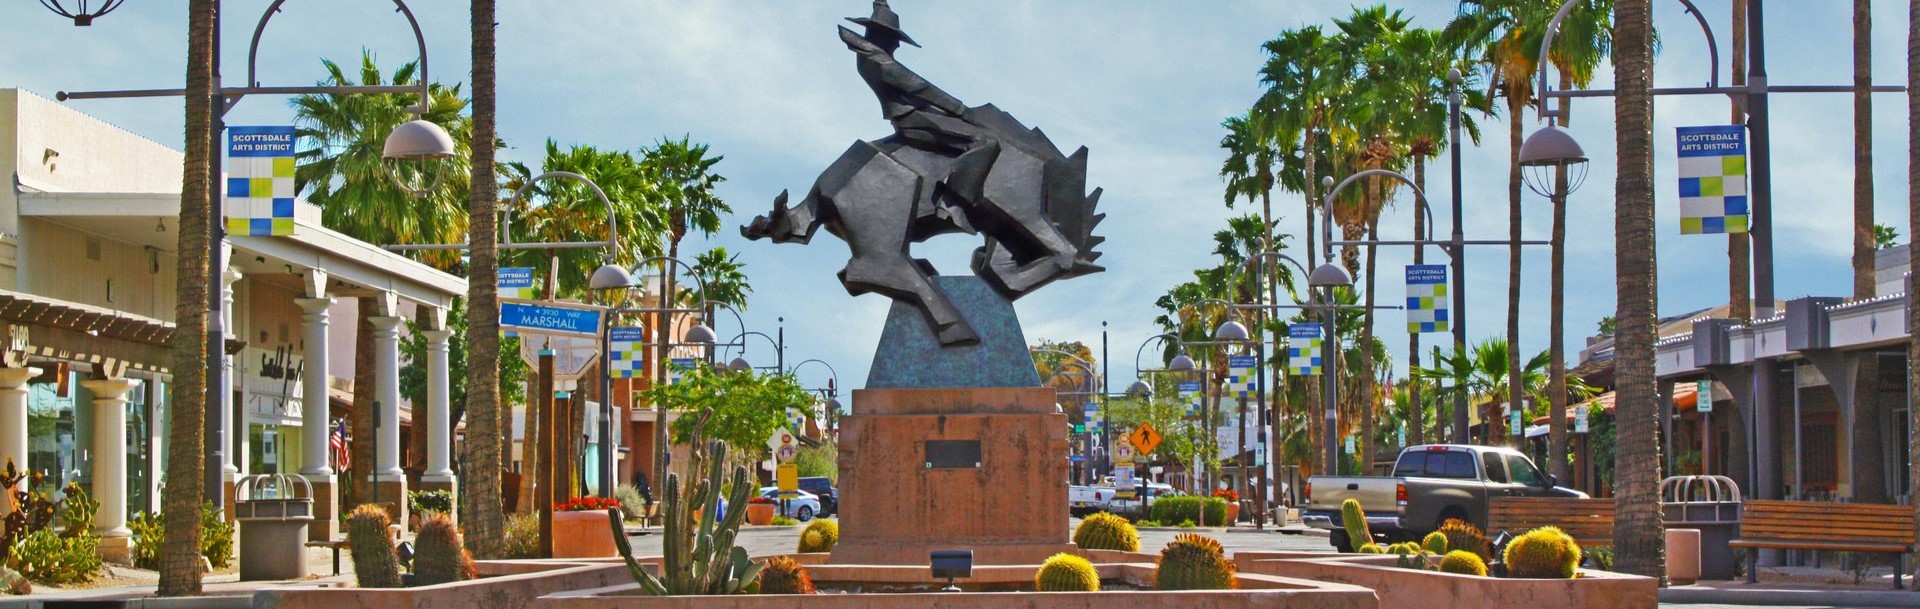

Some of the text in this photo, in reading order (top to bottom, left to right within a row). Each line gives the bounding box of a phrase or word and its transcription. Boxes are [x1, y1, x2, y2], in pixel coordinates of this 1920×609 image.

[232, 134, 291, 142] SCOTTSDALE
[1680, 133, 1740, 142] SCOTTSDALE
[1681, 143, 1702, 151] ARTS
[521, 315, 577, 330] MARSHALL
